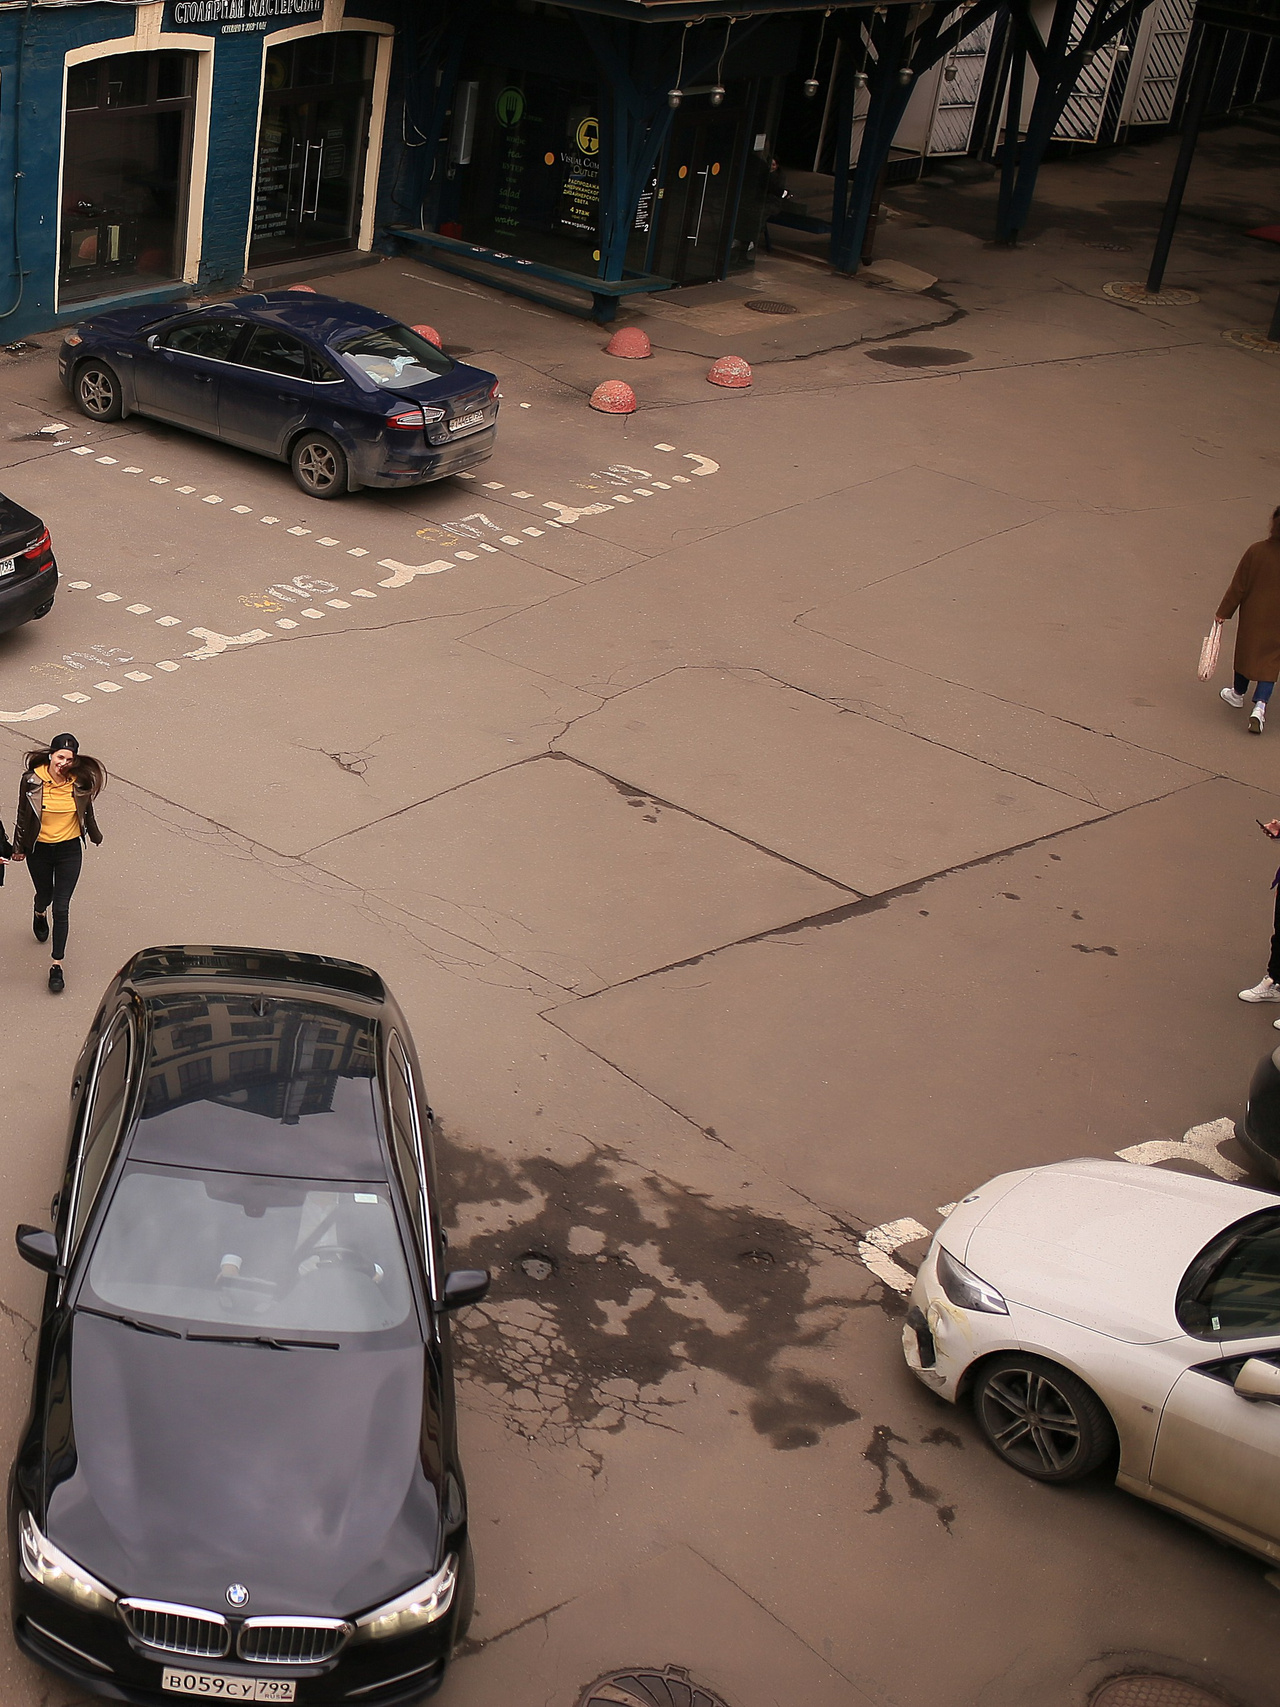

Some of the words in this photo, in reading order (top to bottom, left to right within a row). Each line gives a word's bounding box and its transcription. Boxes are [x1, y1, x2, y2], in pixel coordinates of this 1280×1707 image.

[651, 178, 658, 187] 3
[498, 186, 521, 200] salad
[494, 216, 520, 228] water
[643, 224, 649, 232] 2
[1, 560, 13, 571] 799
[257, 1681, 291, 1696] 799
